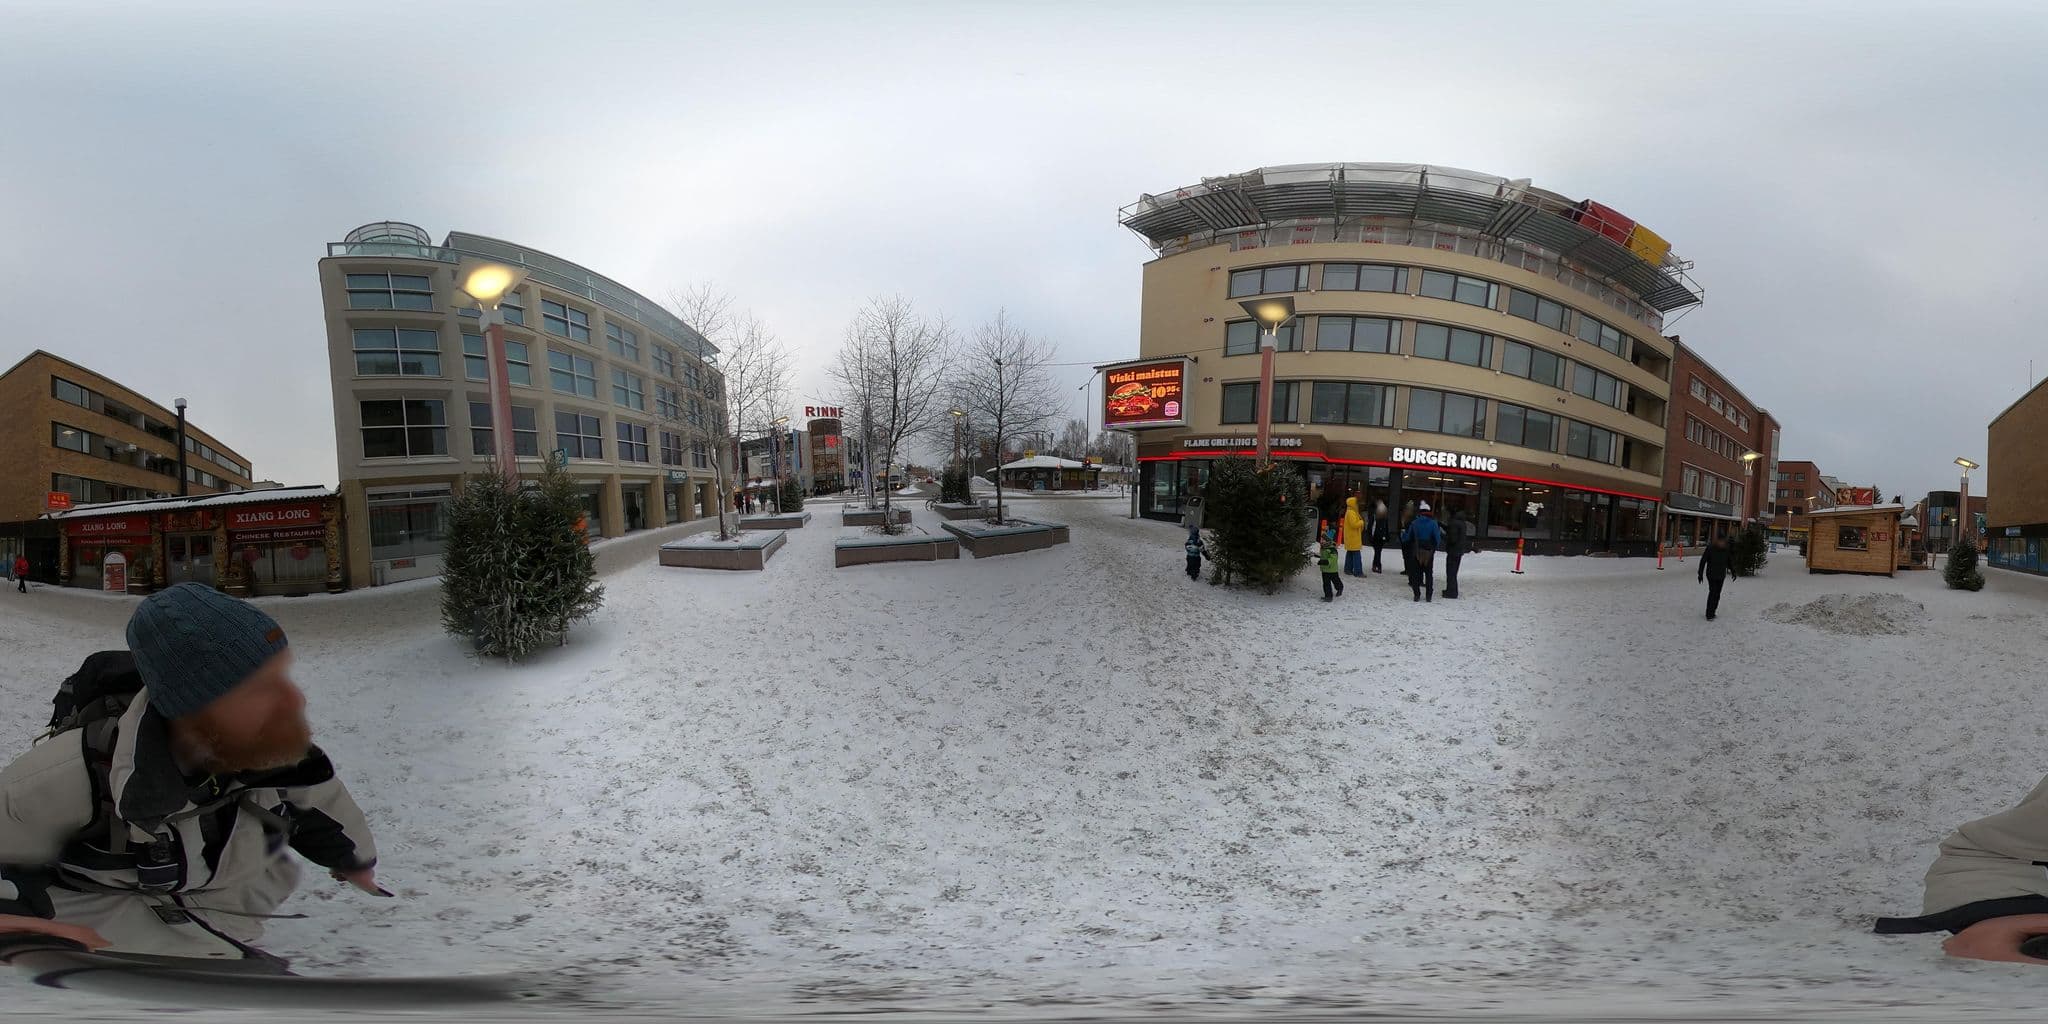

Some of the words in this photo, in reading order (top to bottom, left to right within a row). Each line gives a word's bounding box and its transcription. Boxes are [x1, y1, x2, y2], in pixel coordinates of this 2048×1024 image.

[1109, 371, 1135, 383] Viski
[1136, 369, 1179, 380] maistuu
[805, 406, 844, 418] RINNE
[1184, 439, 1210, 447] FLAME
[1211, 438, 1251, 447] GRILLING
[1393, 447, 1457, 467] BURGER
[1460, 454, 1498, 472] KING
[236, 511, 274, 523] XIANG
[277, 509, 311, 520] LONG
[82, 523, 104, 532] XIANG
[106, 521, 127, 530] LONG
[235, 532, 270, 541] CHINESE
[273, 529, 325, 539] RESTAURANT
